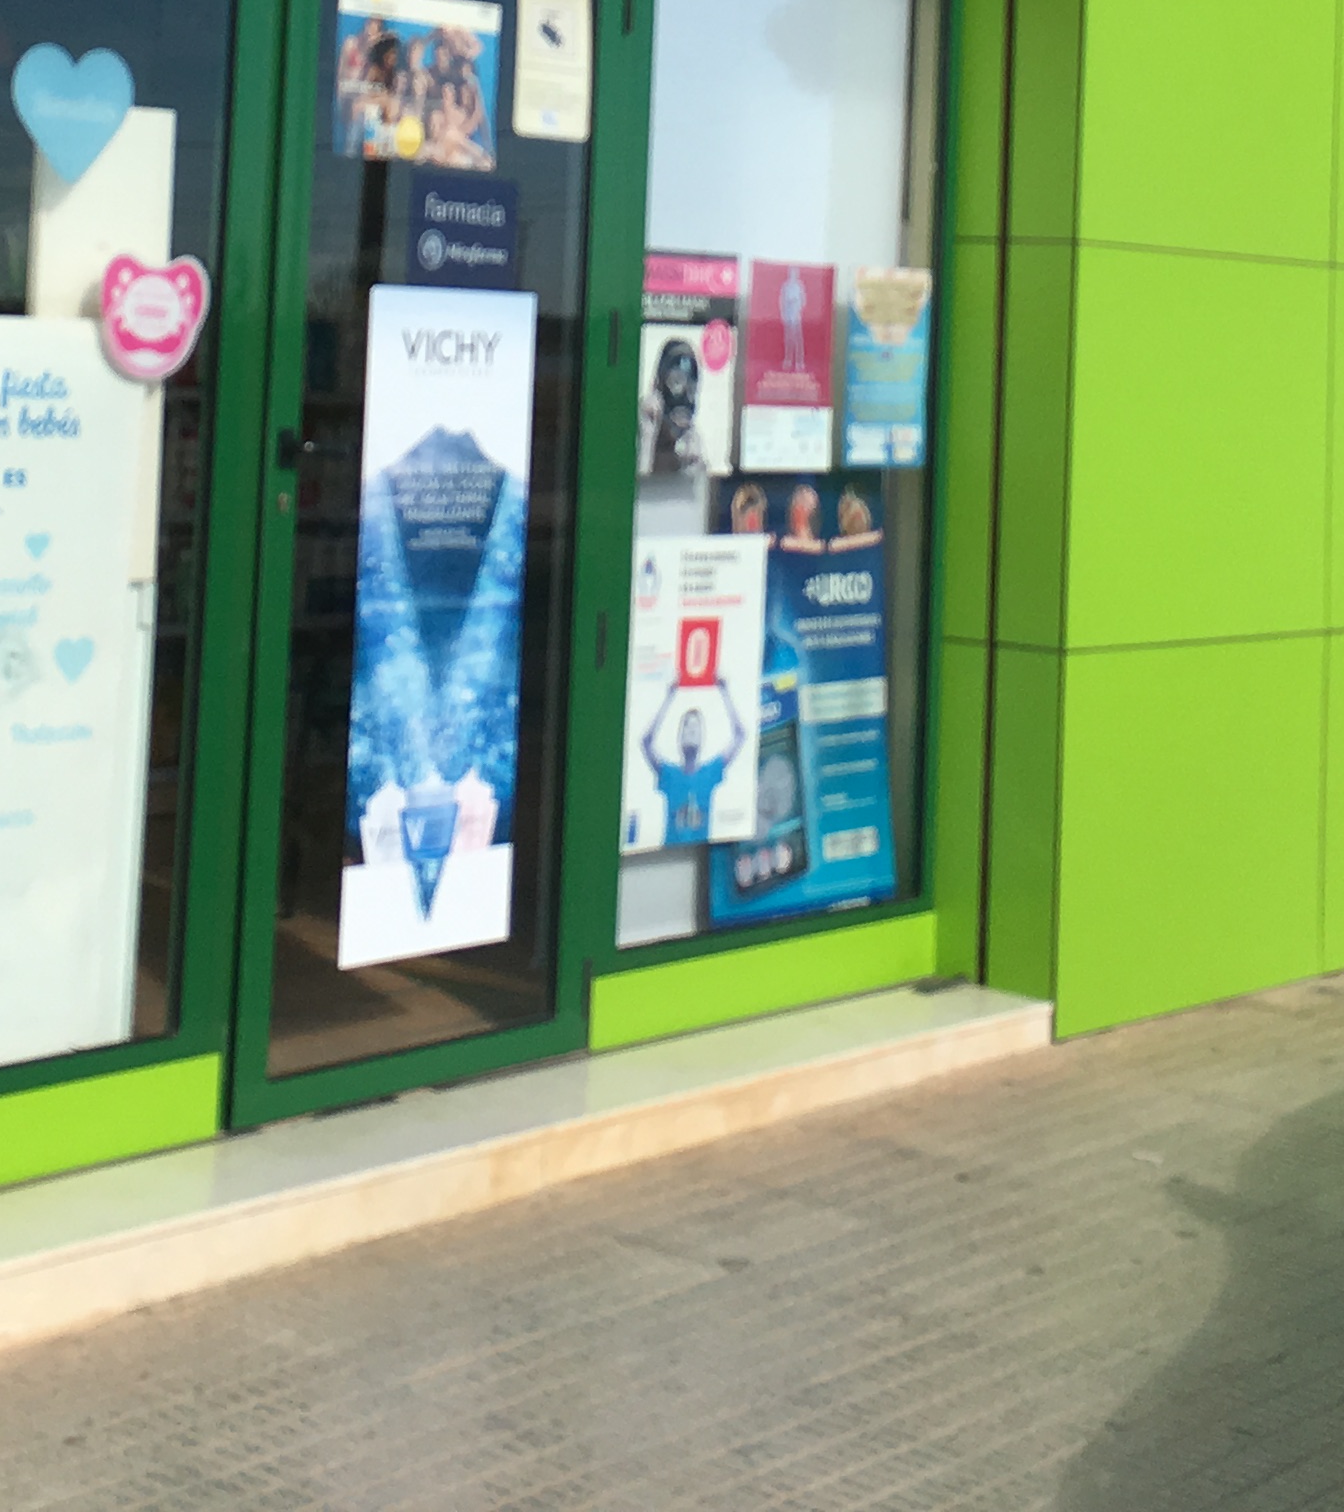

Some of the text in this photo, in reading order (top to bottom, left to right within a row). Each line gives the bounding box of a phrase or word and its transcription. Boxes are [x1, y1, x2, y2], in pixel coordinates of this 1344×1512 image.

[402, 328, 502, 365] VICHY
[0, 367, 69, 407] fiesta
[18, 406, 80, 437] bebés
[3, 468, 27, 487] ES
